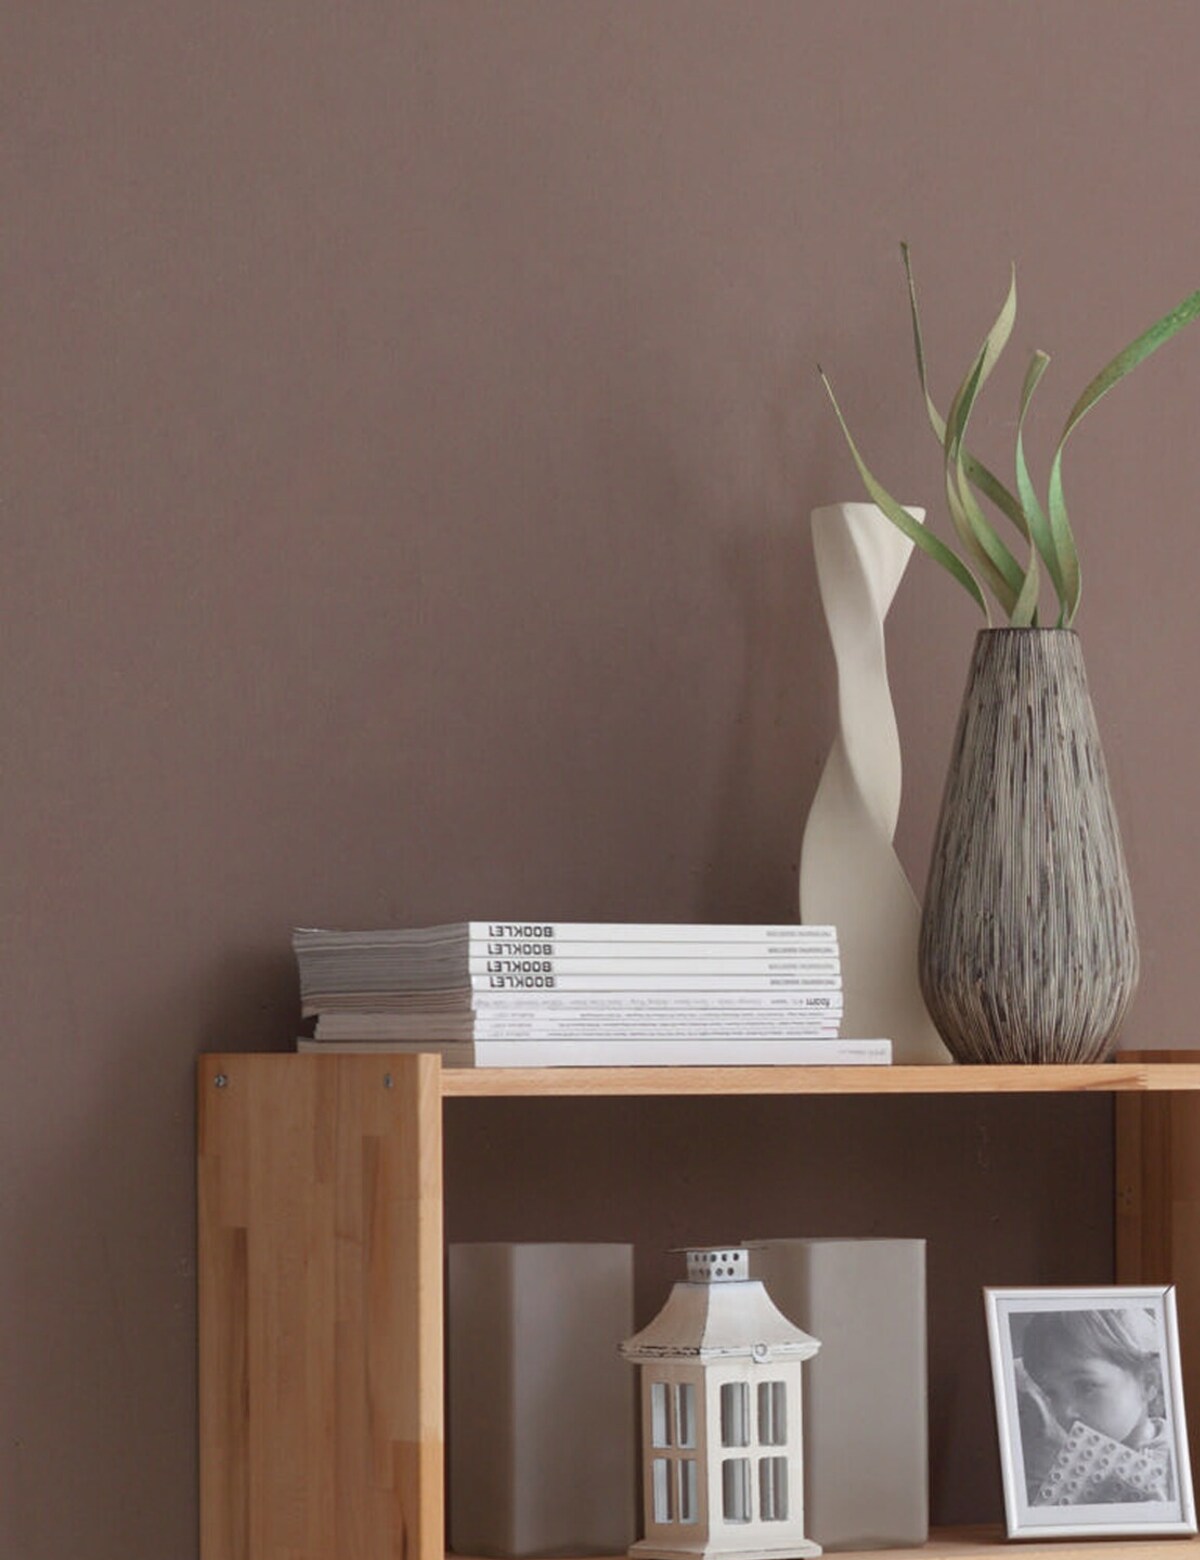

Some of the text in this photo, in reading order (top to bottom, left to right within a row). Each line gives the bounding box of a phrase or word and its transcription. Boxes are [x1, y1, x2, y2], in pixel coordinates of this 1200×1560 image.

[488, 925, 554, 938] BOOKLET
[487, 943, 553, 956] BOOKLET
[486, 960, 552, 973] BOOKLET
[489, 976, 555, 988] BOOKLET
